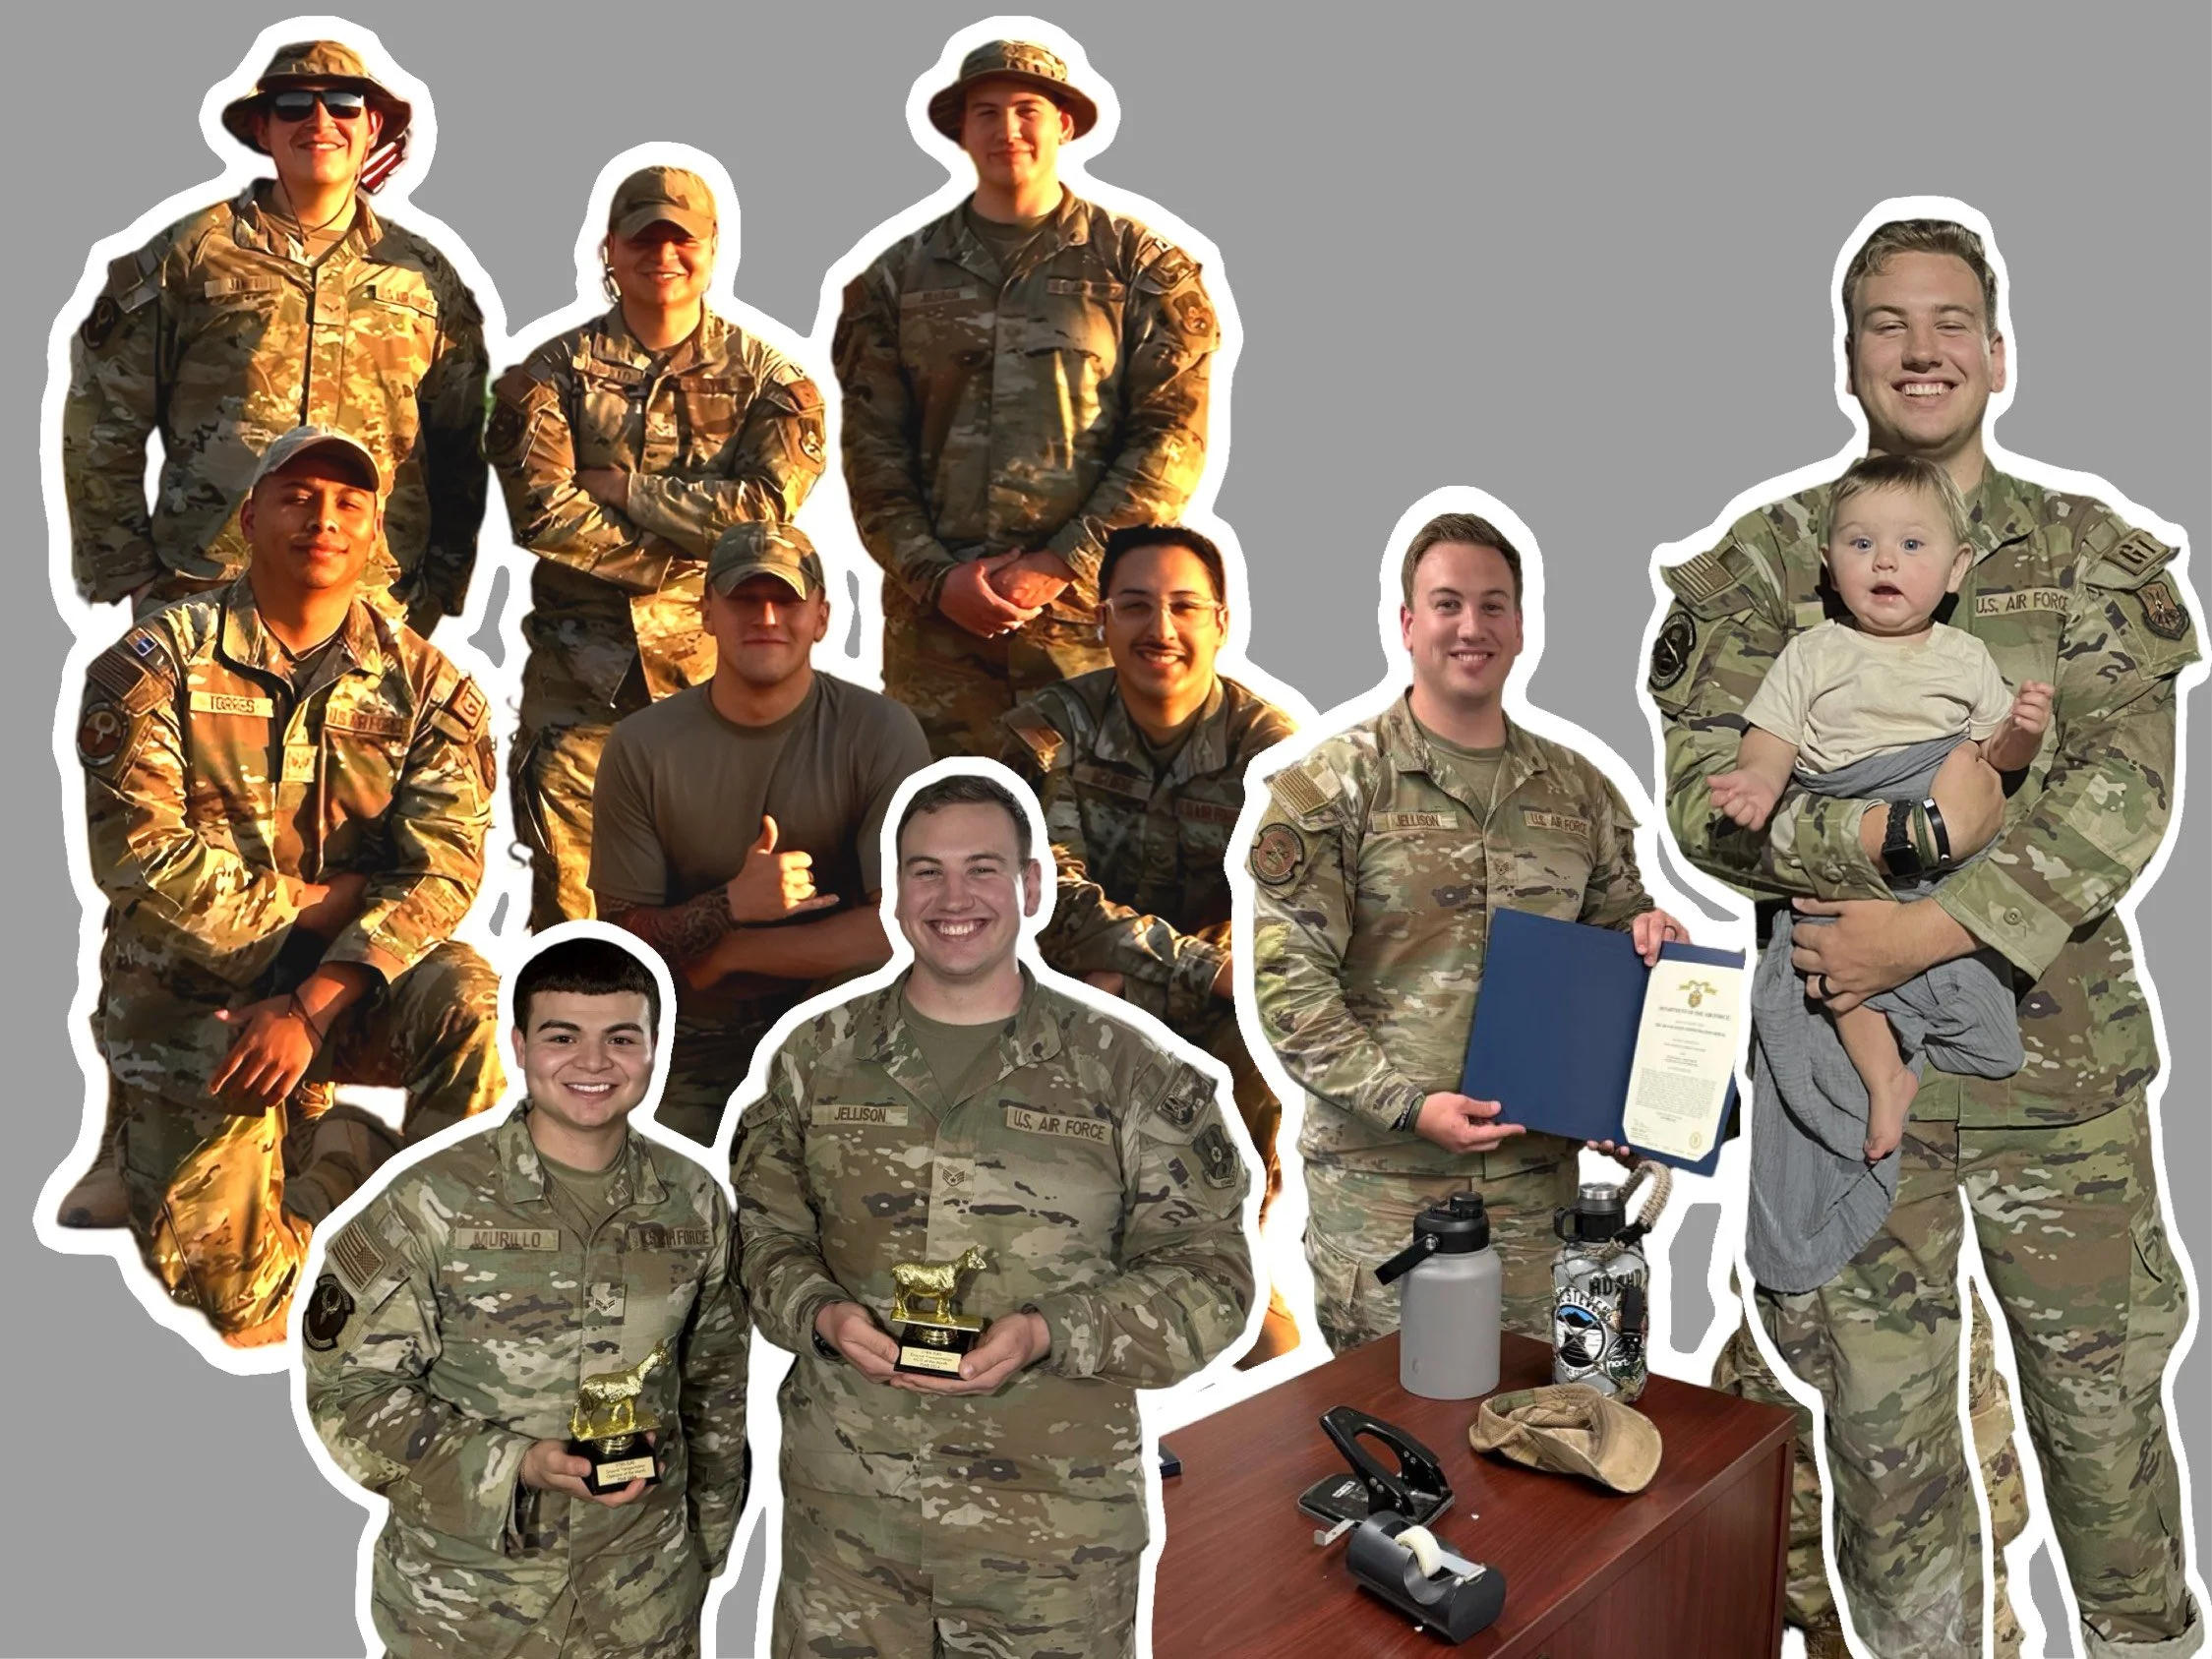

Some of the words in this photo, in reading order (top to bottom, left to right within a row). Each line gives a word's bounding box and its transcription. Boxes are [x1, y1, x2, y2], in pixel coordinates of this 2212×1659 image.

[2119, 539, 2158, 564] GT
[1976, 599, 1999, 614] U.S.
[2005, 595, 2028, 611] AIR
[209, 694, 256, 714] TORRES
[1395, 813, 1440, 827] JELLISON
[1551, 815, 1564, 829] AIR
[1564, 818, 1587, 836] FORCE
[834, 1105, 886, 1123] JELLISON
[1014, 1111, 1033, 1130] U.S.
[1039, 1117, 1060, 1134] AIR
[1065, 1120, 1106, 1141] FORCE
[474, 1231, 542, 1249] MURILLO
[677, 1229, 711, 1246] FORCE
